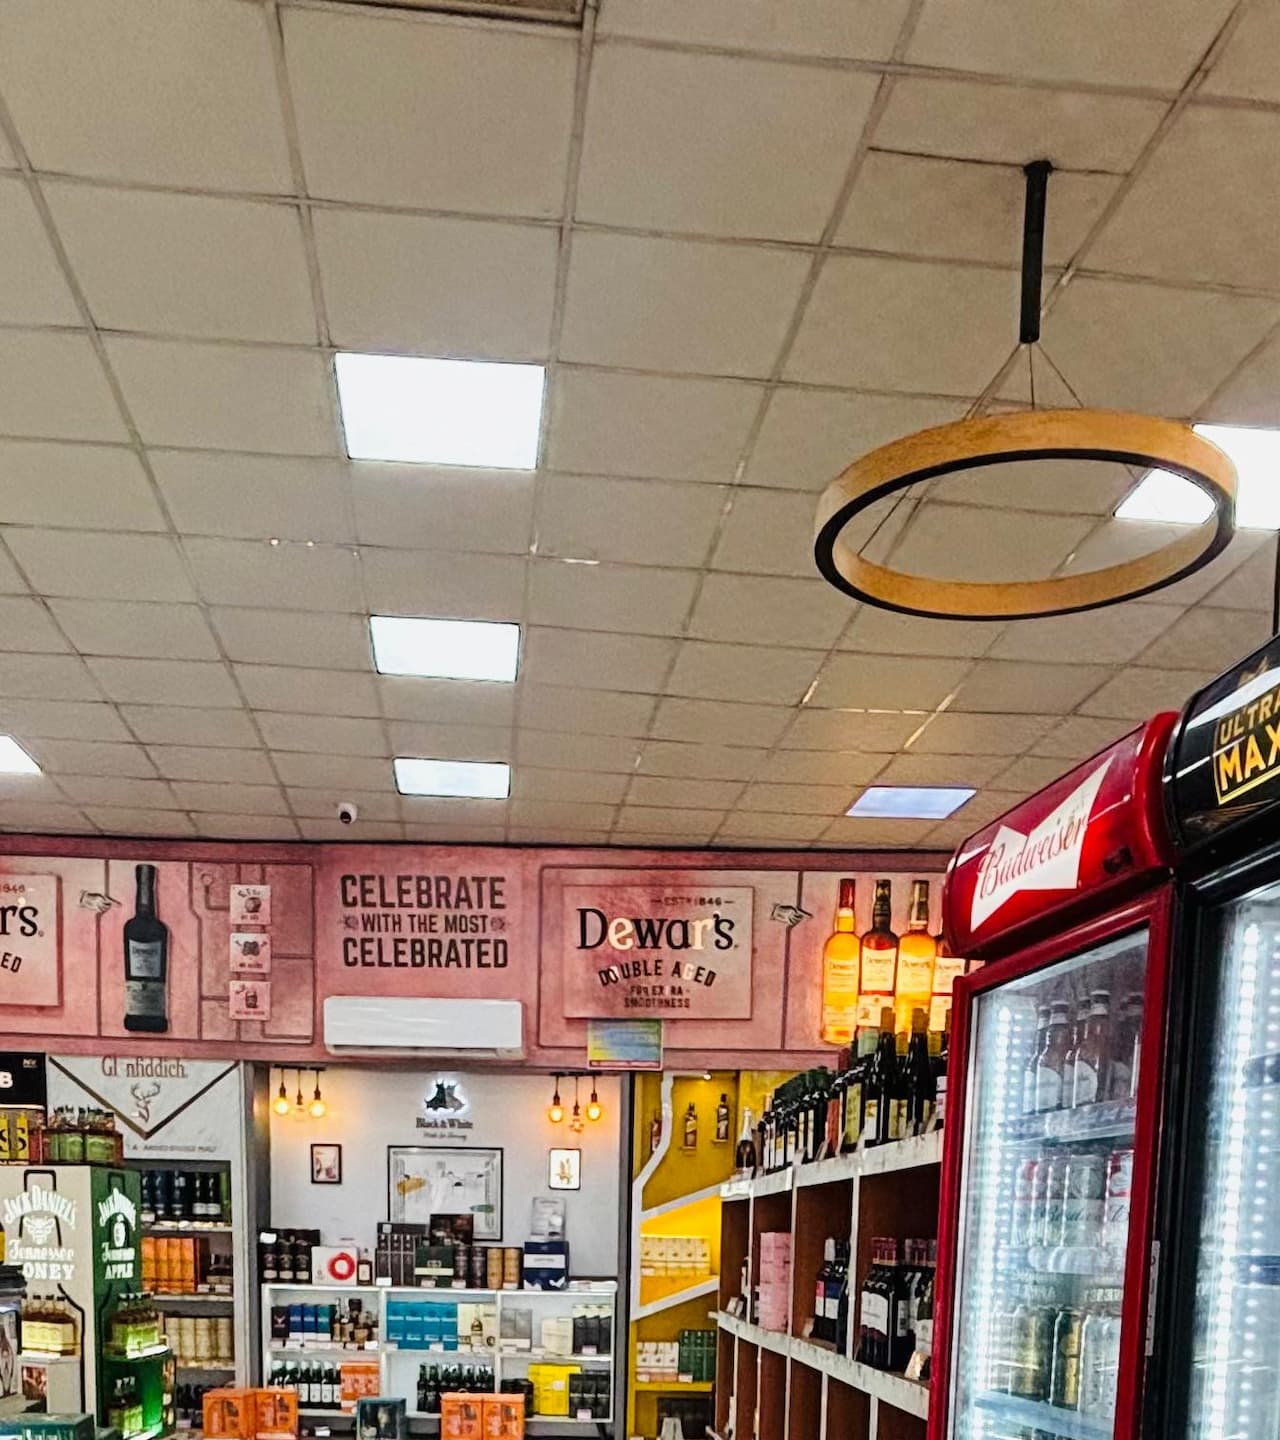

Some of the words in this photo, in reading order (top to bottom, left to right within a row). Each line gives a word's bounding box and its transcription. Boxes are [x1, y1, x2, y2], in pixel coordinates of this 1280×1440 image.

[978, 814, 1087, 901] Budweiser
[340, 874, 507, 909] CELEBRATE
[361, 914, 401, 932] WITH
[408, 914, 438, 933] THE
[444, 915, 488, 933] MOST
[576, 908, 735, 950] Dewar's
[343, 937, 508, 968] CELEBRATED
[598, 960, 663, 986] DOUBLE
[671, 961, 716, 987] AGED
